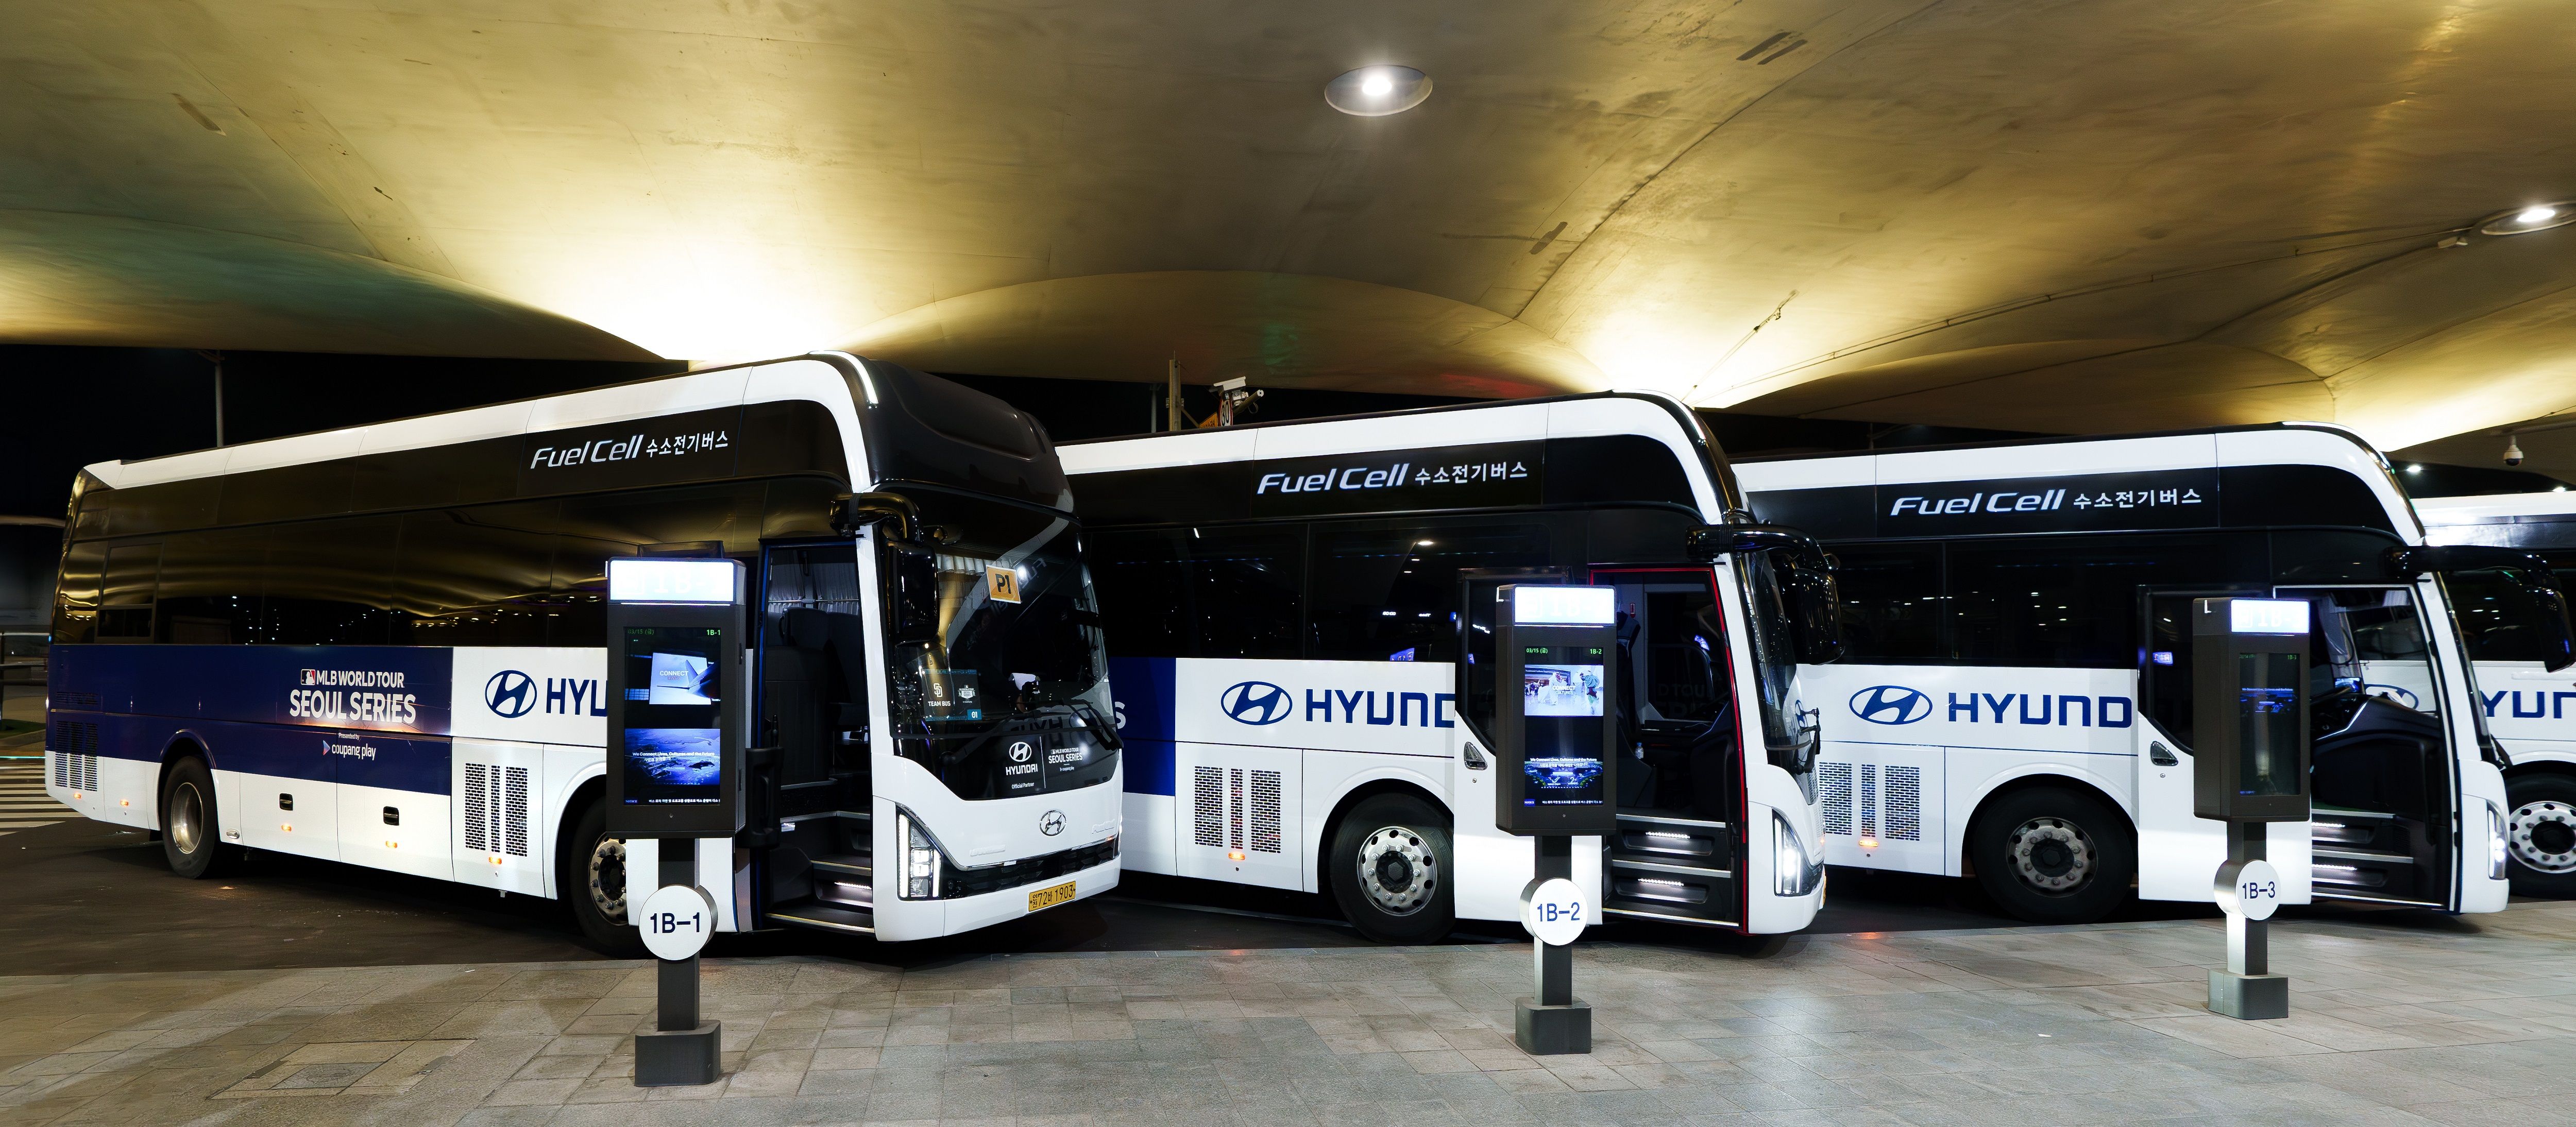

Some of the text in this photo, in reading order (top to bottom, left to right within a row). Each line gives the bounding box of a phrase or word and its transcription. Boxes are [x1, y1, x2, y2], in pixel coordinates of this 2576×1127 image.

[1221, 400, 1230, 426] 30
[531, 431, 728, 469] Fuel Cell 수소전기버스
[1257, 462, 1528, 494] Fuel Cell 수소전기버스
[1890, 488, 2202, 516] Fuel Cell 수소전기버스
[995, 573, 1012, 594] P1
[316, 670, 405, 688] MLB WORLD TOUR
[290, 689, 416, 724] SEOUL SERIES
[1306, 689, 1455, 728] HYUND
[1947, 692, 2132, 728] HYUND
[331, 743, 376, 761] coupang play
[1048, 753, 1083, 764] SEOUL SERIES
[1006, 763, 1038, 776] HYUNDAI
[1032, 884, 1073, 908] 인천 72바 1903
[2242, 881, 2276, 899] 1B-3
[650, 912, 700, 934] 1B-1
[1537, 902, 1580, 922] 1B-2
